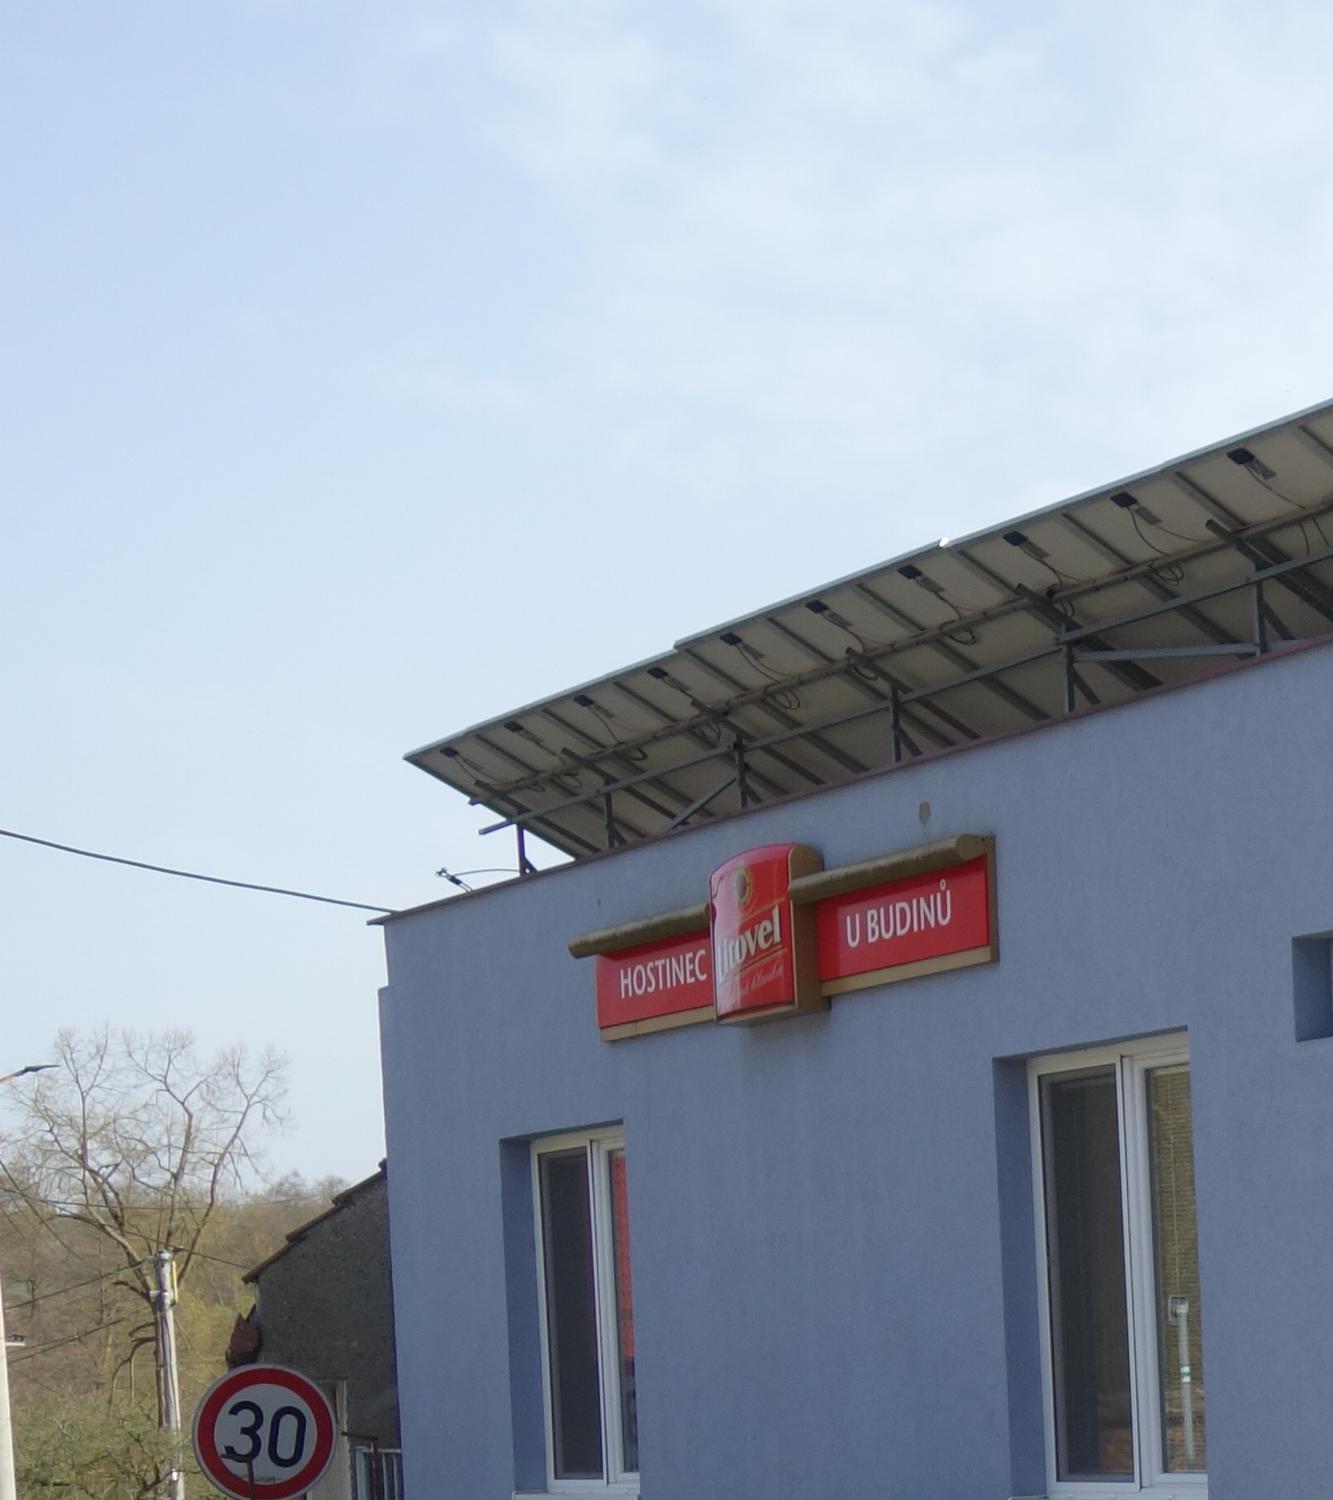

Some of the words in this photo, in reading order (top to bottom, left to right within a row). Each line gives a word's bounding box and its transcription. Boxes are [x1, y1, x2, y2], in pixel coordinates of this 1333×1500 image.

[619, 949, 707, 999] HOSTINEC
[845, 914, 861, 949] U
[865, 878, 952, 944] BUDINŮ
[223, 1400, 307, 1468] 30
